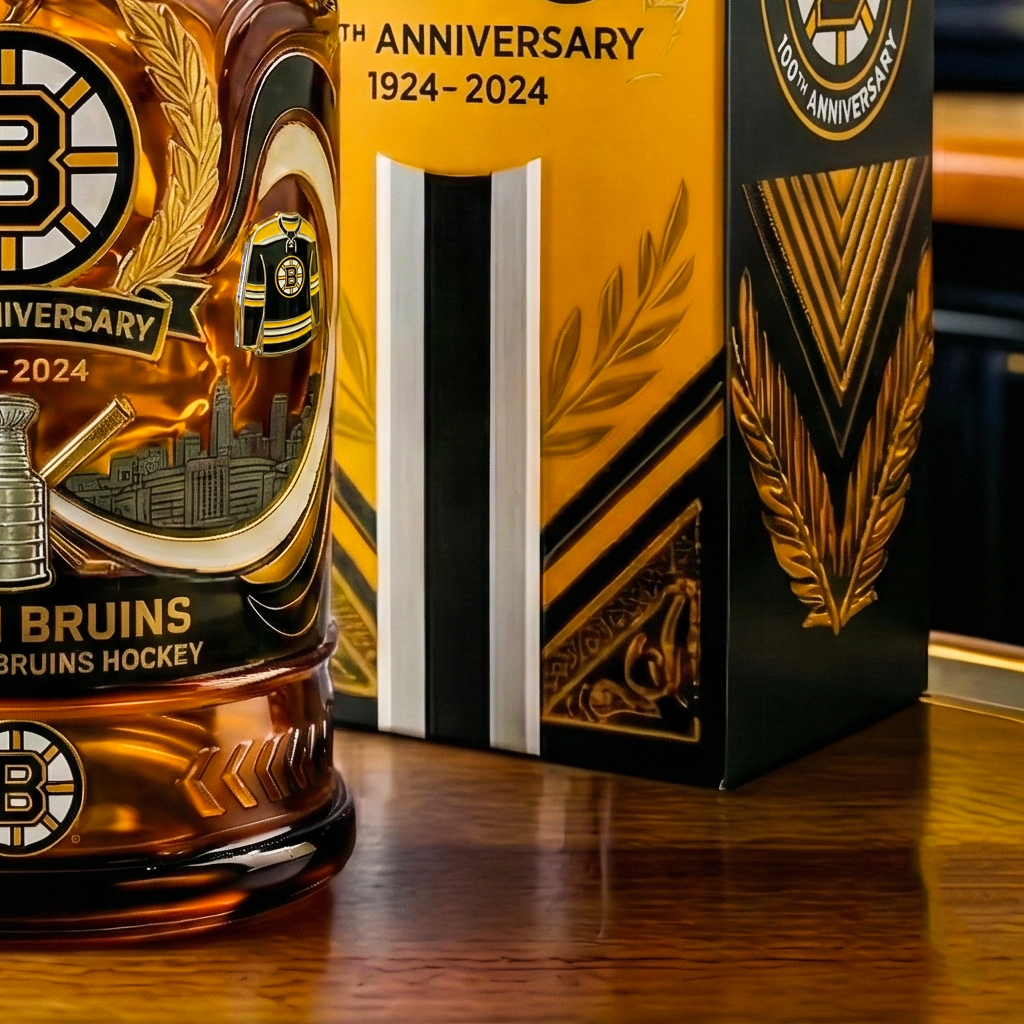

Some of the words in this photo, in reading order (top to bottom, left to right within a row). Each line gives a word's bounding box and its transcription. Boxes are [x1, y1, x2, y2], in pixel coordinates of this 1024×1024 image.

[375, 22, 645, 61] ANNIVERSARY
[777, 33, 809, 96] 100TH
[806, 27, 897, 125] ANNIVERSARY
[20, 595, 192, 644] BRUINS
[101, 641, 205, 671] HOCKEY
